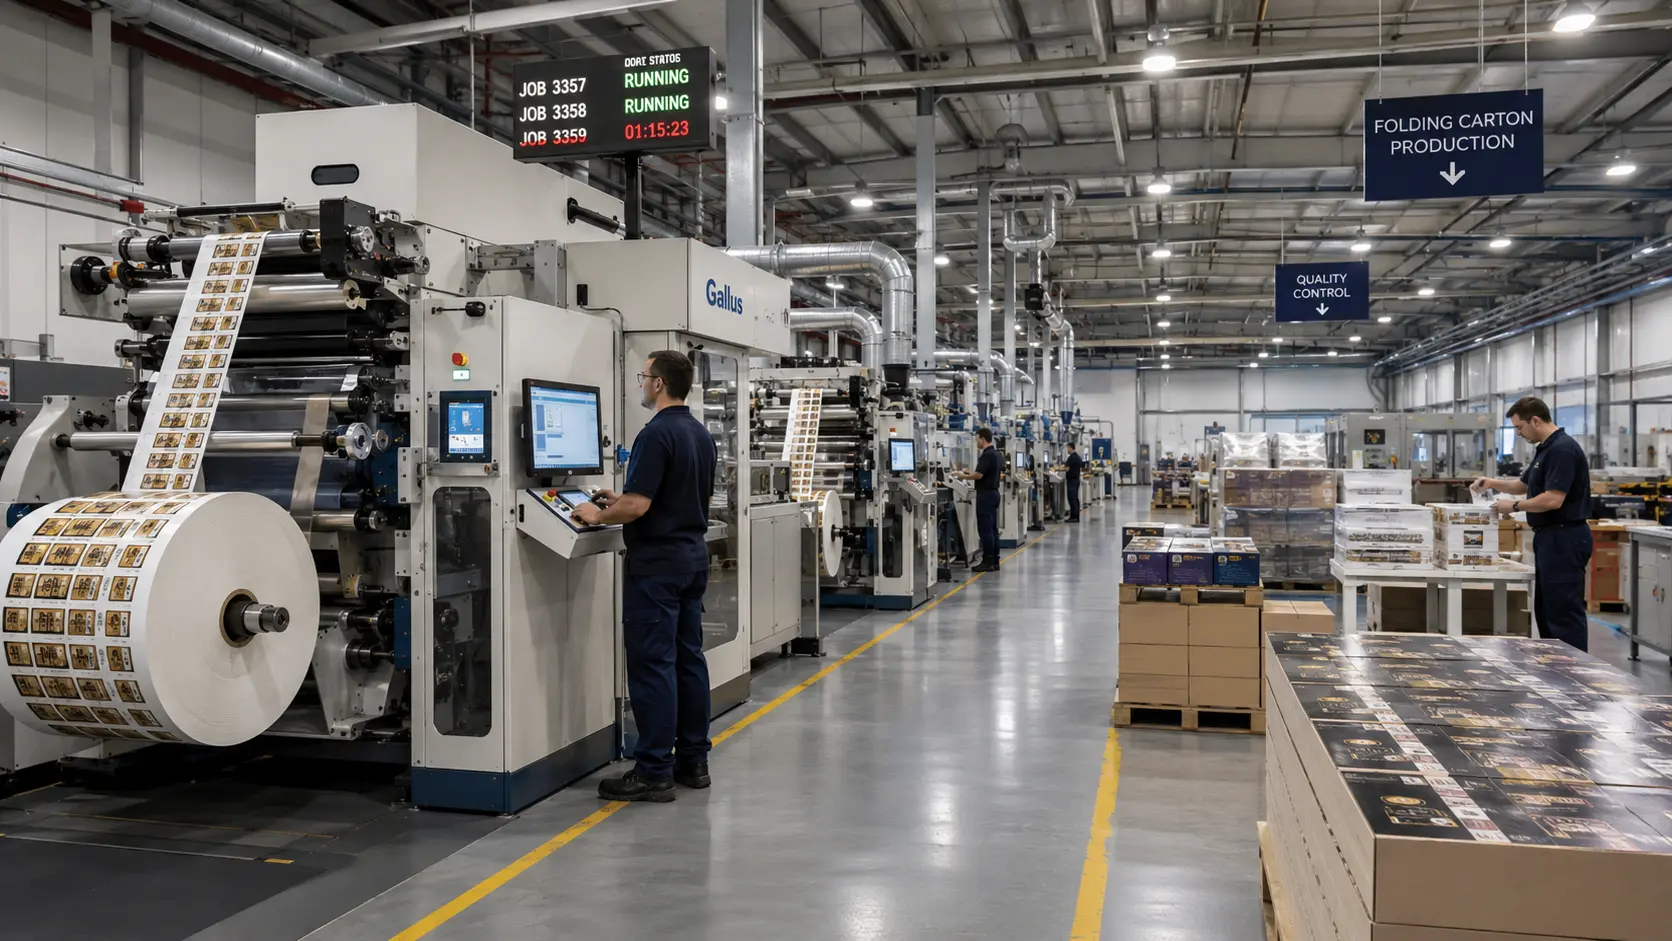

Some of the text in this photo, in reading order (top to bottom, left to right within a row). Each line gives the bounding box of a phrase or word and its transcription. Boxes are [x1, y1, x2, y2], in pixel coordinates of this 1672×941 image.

[519, 78, 586, 97] JOB 3357
[625, 68, 689, 88] RUNNING
[519, 103, 586, 122] JOB 3358
[625, 94, 689, 113] RUNNING
[625, 120, 689, 139] 01:15:23
[1375, 110, 1533, 133] FOLDING CARTON
[520, 128, 587, 146] JOB 3359
[1391, 133, 1515, 155] PRODUCTION
[1296, 274, 1347, 286] QUALITY
[706, 279, 743, 314] Gallus
[1293, 288, 1350, 299] CONTROL
